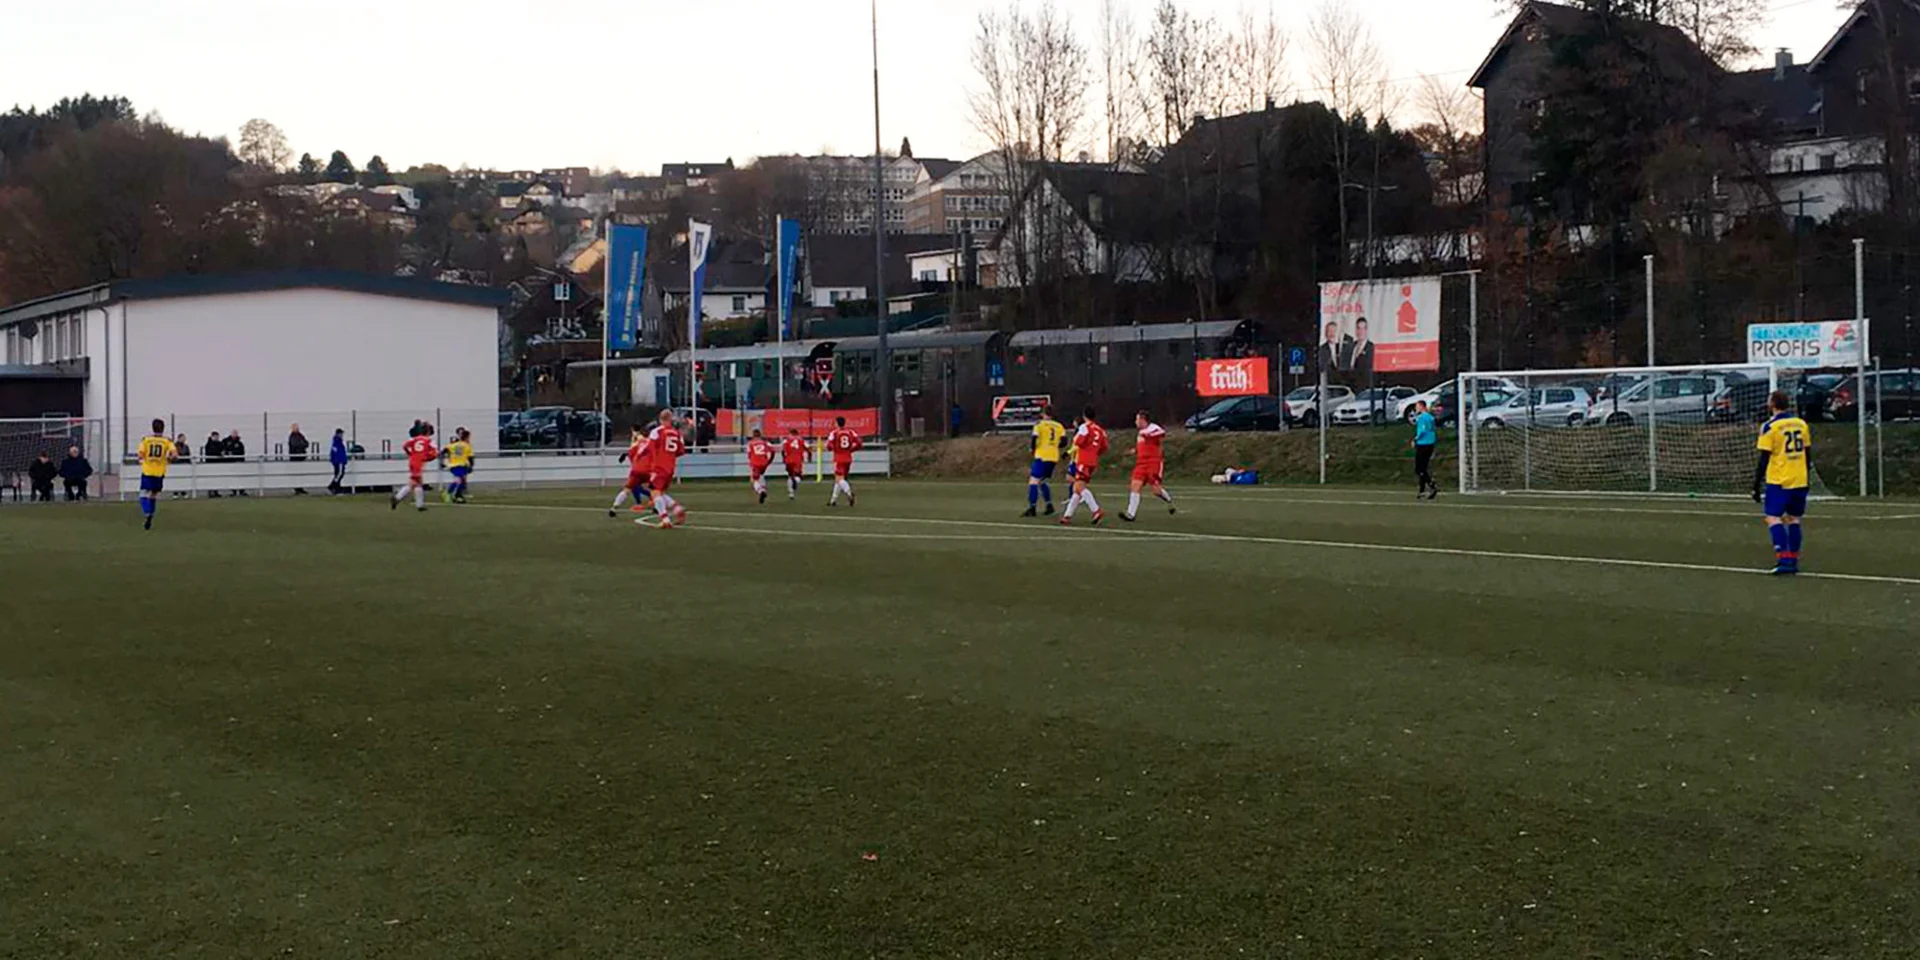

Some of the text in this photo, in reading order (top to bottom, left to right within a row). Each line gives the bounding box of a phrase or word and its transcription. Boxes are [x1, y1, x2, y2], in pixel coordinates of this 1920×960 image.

[1752, 339, 1820, 357] PROFIS
[1210, 363, 1247, 391] früh
[414, 440, 425, 452] 6
[665, 436, 678, 453] 15
[789, 438, 799, 449] 4
[839, 436, 850, 449] 8
[1784, 430, 1804, 453] 26
[148, 444, 163, 458] 10
[753, 444, 765, 455] 12
